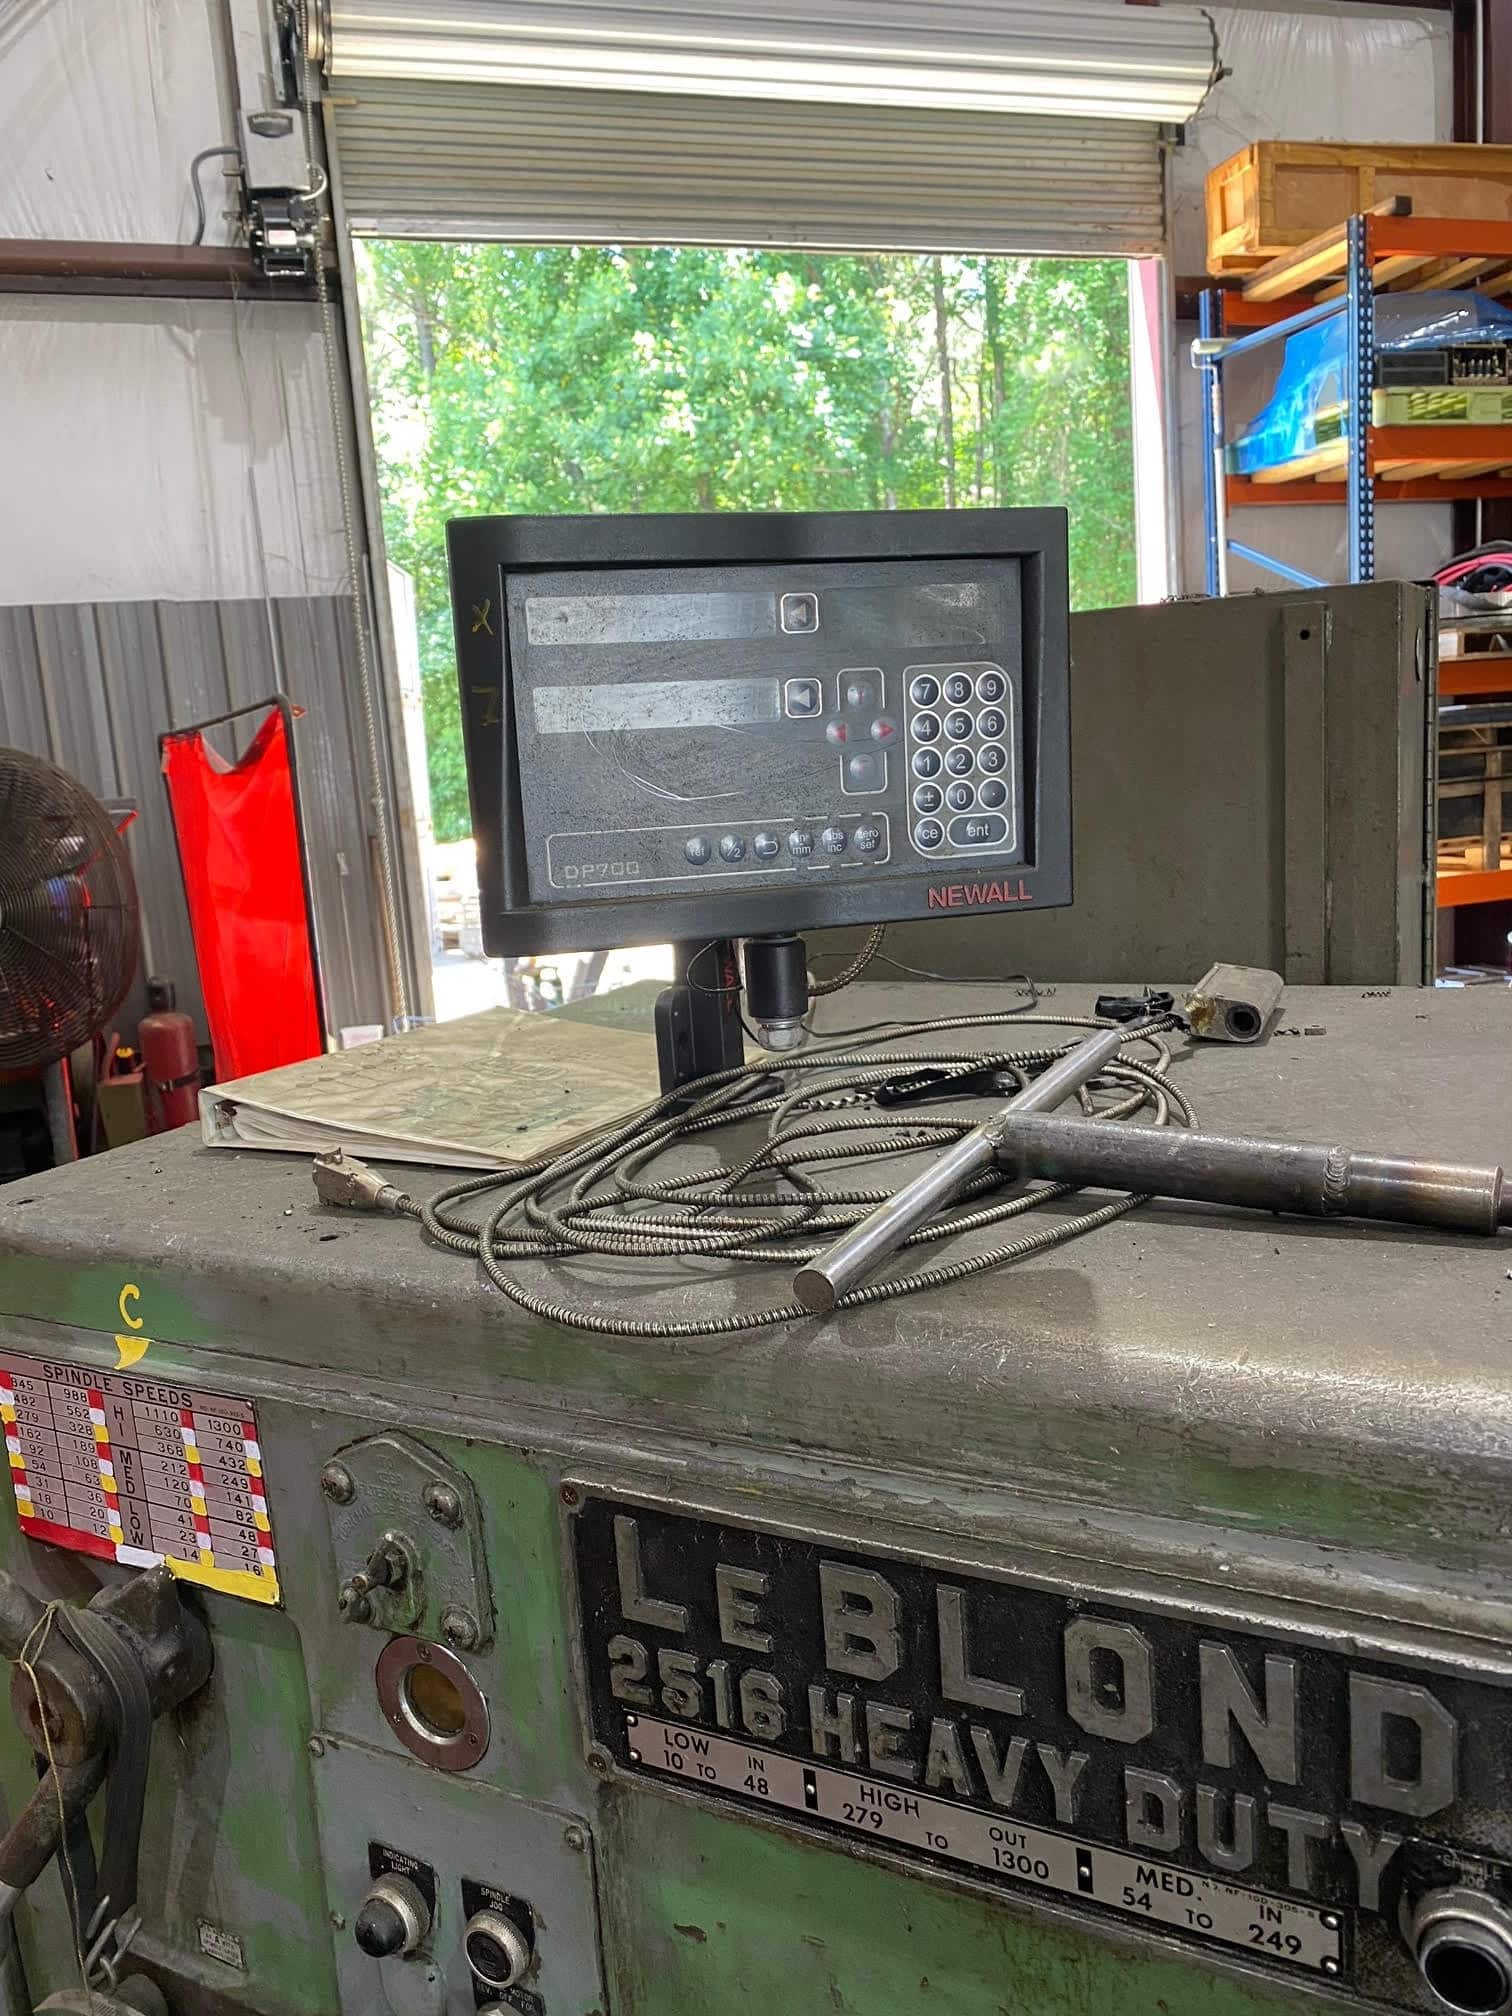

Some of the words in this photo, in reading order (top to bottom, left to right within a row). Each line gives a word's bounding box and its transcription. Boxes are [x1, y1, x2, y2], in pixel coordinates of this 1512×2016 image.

[918, 681, 933, 701] 7
[952, 680, 966, 699] 8
[984, 678, 998, 697] 9
[918, 718, 933, 737] 4
[953, 716, 966, 735] 5
[986, 714, 998, 733] 6
[922, 754, 932, 773] 1
[954, 752, 968, 770] 2
[986, 750, 1000, 769] 3
[955, 788, 968, 806] 0
[921, 825, 939, 842] ce
[966, 821, 990, 840] ent
[792, 845, 811, 854] mm
[827, 842, 842, 852] inc
[565, 861, 640, 879] DP700
[927, 879, 1033, 910] NEWALL
[118, 1283, 144, 1330] C
[42, 1364, 113, 1392] SPINDLE
[123, 1382, 193, 1408] SPEEDS
[13, 1393, 36, 1408] 482
[63, 1388, 87, 1403] 988
[16, 1408, 39, 1423] 279
[66, 1405, 90, 1419] 562
[144, 1406, 179, 1423] 1110
[19, 1426, 42, 1441] 162
[68, 1421, 93, 1436] 328
[154, 1423, 181, 1440] 630
[208, 1419, 241, 1436] 1300
[28, 1442, 44, 1455] 92
[72, 1438, 95, 1453] 189
[158, 1441, 184, 1457] 368
[215, 1436, 243, 1453] 740
[31, 1458, 47, 1472] 54
[74, 1454, 98, 1469] 108
[160, 1459, 188, 1475] 212
[219, 1454, 246, 1470] 432
[35, 1475, 50, 1489] 31
[85, 1472, 100, 1485] 63
[163, 1476, 189, 1492] 120
[221, 1473, 249, 1490] 249
[37, 1490, 52, 1505] 18
[86, 1488, 103, 1504] 36
[174, 1494, 191, 1508] 70
[226, 1490, 251, 1506] 141
[40, 1506, 55, 1520] 10
[89, 1504, 106, 1519] 20
[177, 1510, 194, 1525] 41
[235, 1507, 253, 1523] 82
[92, 1520, 107, 1535] 12
[179, 1527, 197, 1543] 23
[238, 1526, 256, 1542] 48
[182, 1544, 199, 1560] 14
[240, 1542, 258, 1559] 27
[243, 1560, 261, 1576] 16
[663, 1726, 710, 1756] LOW
[745, 1753, 766, 1774] IN
[606, 1632, 789, 1742] 2516
[806, 1682, 1091, 1825] HEAVY
[1123, 1762, 1404, 1913] DUTY
[661, 1748, 684, 1771] 10
[695, 1760, 717, 1780] TO
[742, 1771, 770, 1797] 48
[859, 1783, 921, 1820] HIGH
[841, 1800, 884, 1831] 279
[987, 1823, 1028, 1849] OUT
[924, 1830, 950, 1849] TO
[990, 1846, 1050, 1880] 1300
[1134, 1864, 1202, 1901] MED.
[480, 1887, 510, 1904] SPINDLE
[489, 1900, 503, 1912] JOG
[1120, 1885, 1153, 1912] 54
[1185, 1907, 1214, 1930] TO
[1247, 1922, 1303, 1957] 249
[1259, 1905, 1282, 1924] IN
